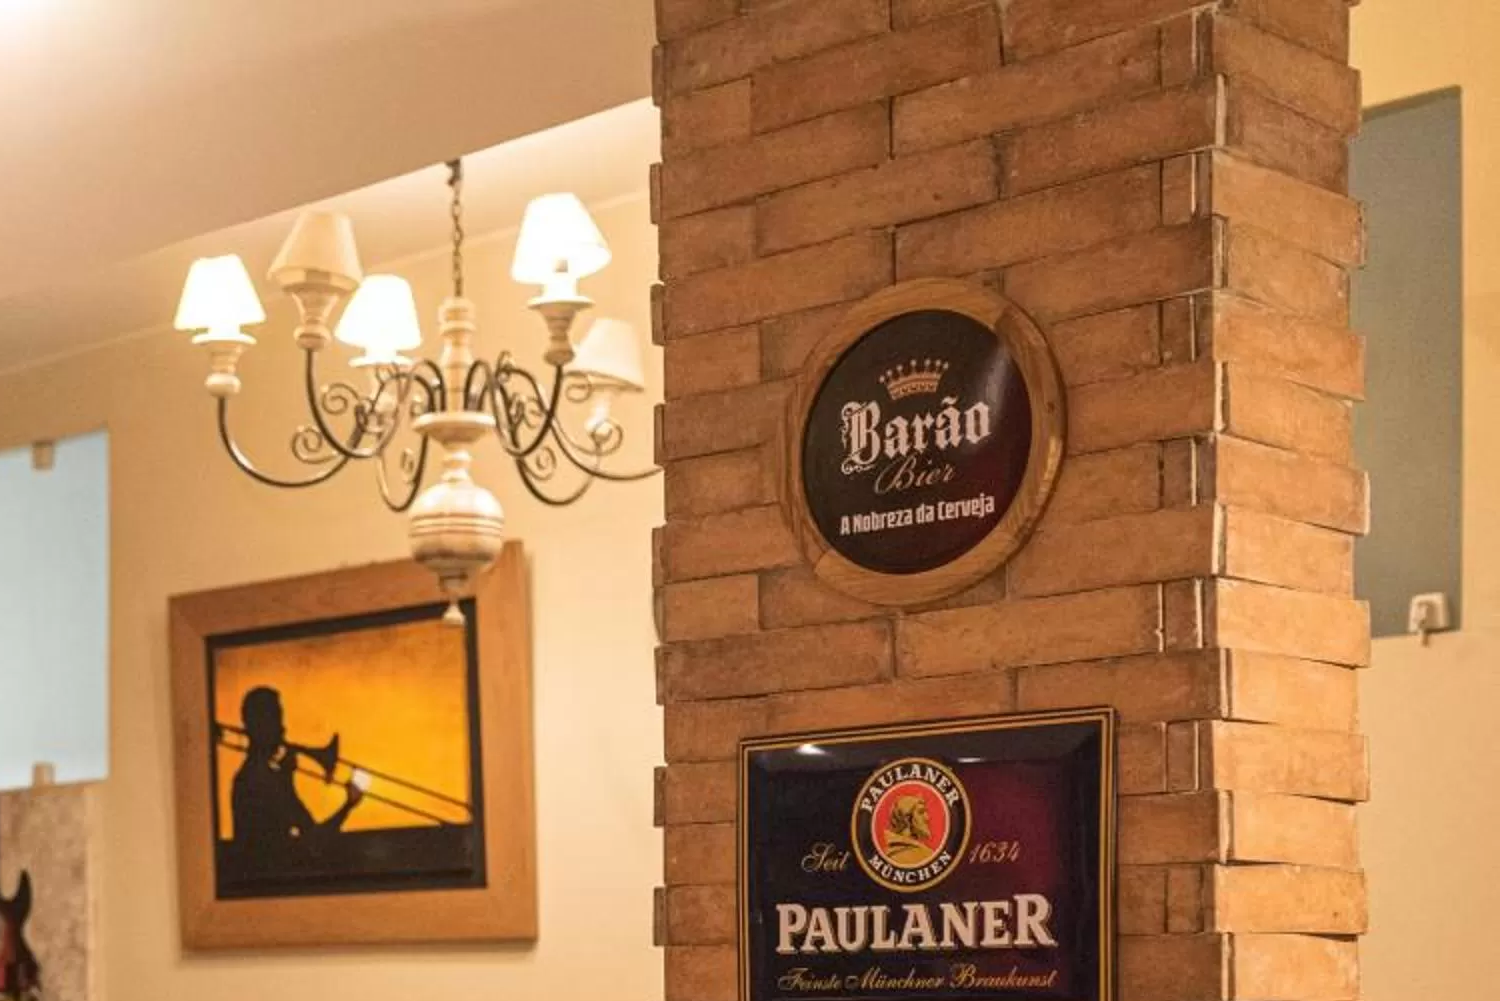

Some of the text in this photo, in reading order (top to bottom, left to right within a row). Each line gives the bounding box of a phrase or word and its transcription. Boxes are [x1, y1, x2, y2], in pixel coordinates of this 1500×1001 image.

[838, 396, 991, 475] Barão
[874, 454, 955, 494] Bier
[840, 492, 995, 535] A Nobreza da Cerveja
[861, 763, 959, 814] PAULANER
[801, 840, 1020, 873] Seit 1634
[868, 851, 952, 883] MÜNCHEN
[775, 893, 1058, 954] PAULANER
[777, 963, 1058, 991] Feinste Münchner Braukunst
